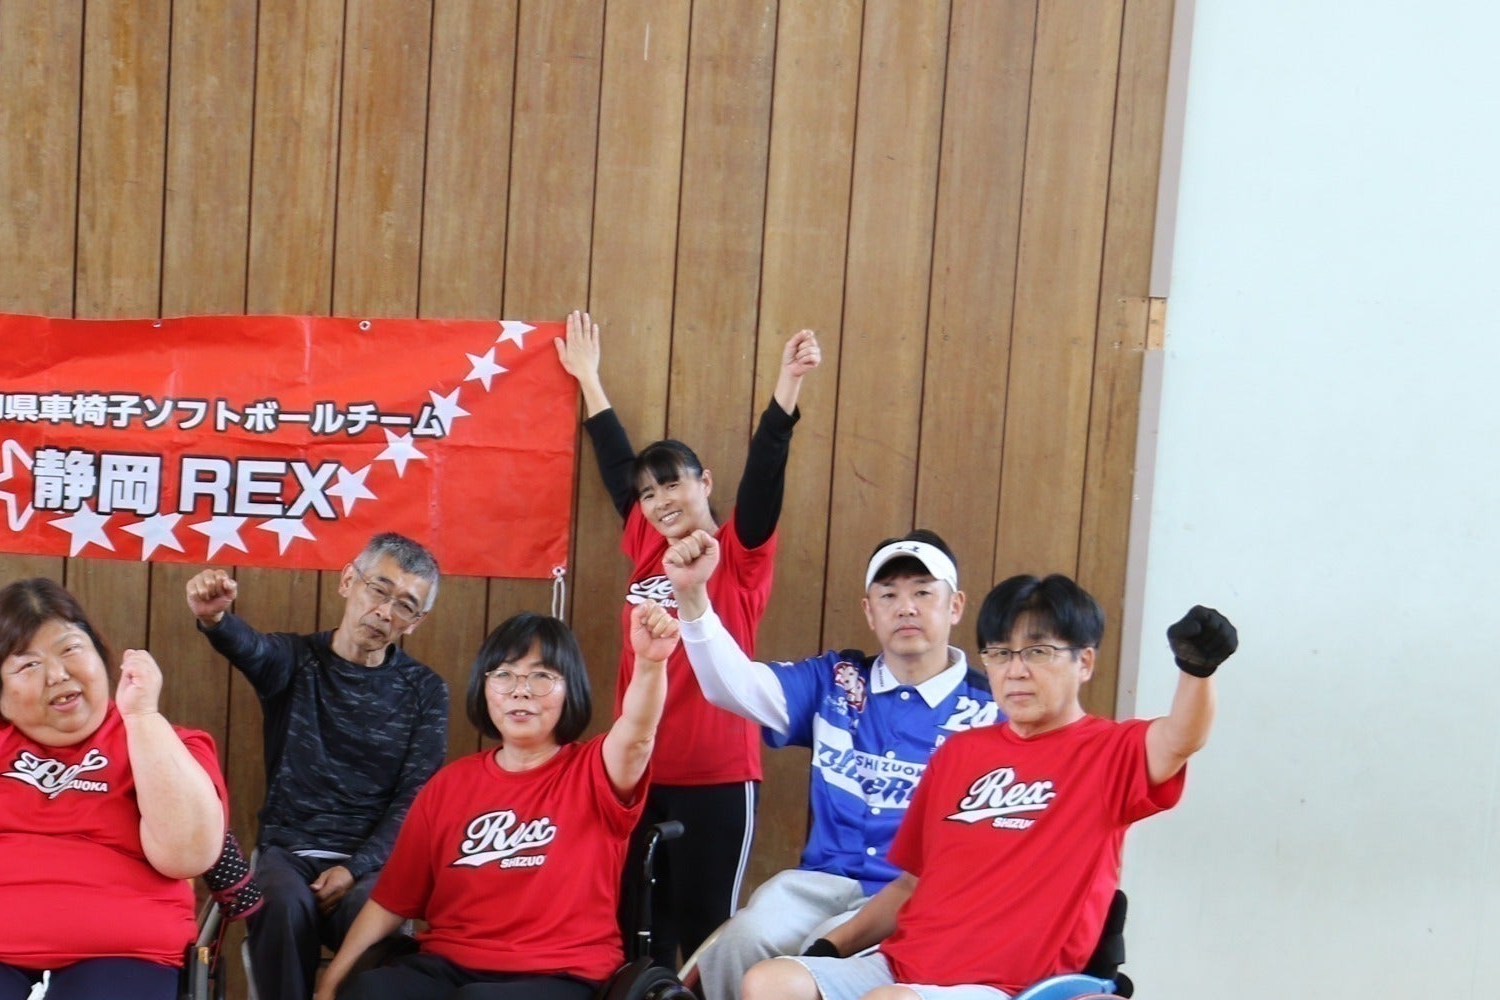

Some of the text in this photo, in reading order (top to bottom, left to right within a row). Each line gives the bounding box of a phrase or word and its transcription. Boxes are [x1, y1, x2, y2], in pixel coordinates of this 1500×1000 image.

[32, 448, 340, 519] 静岡 REX
[960, 767, 1057, 810] Rex
[500, 855, 546, 869] SHIZUO
